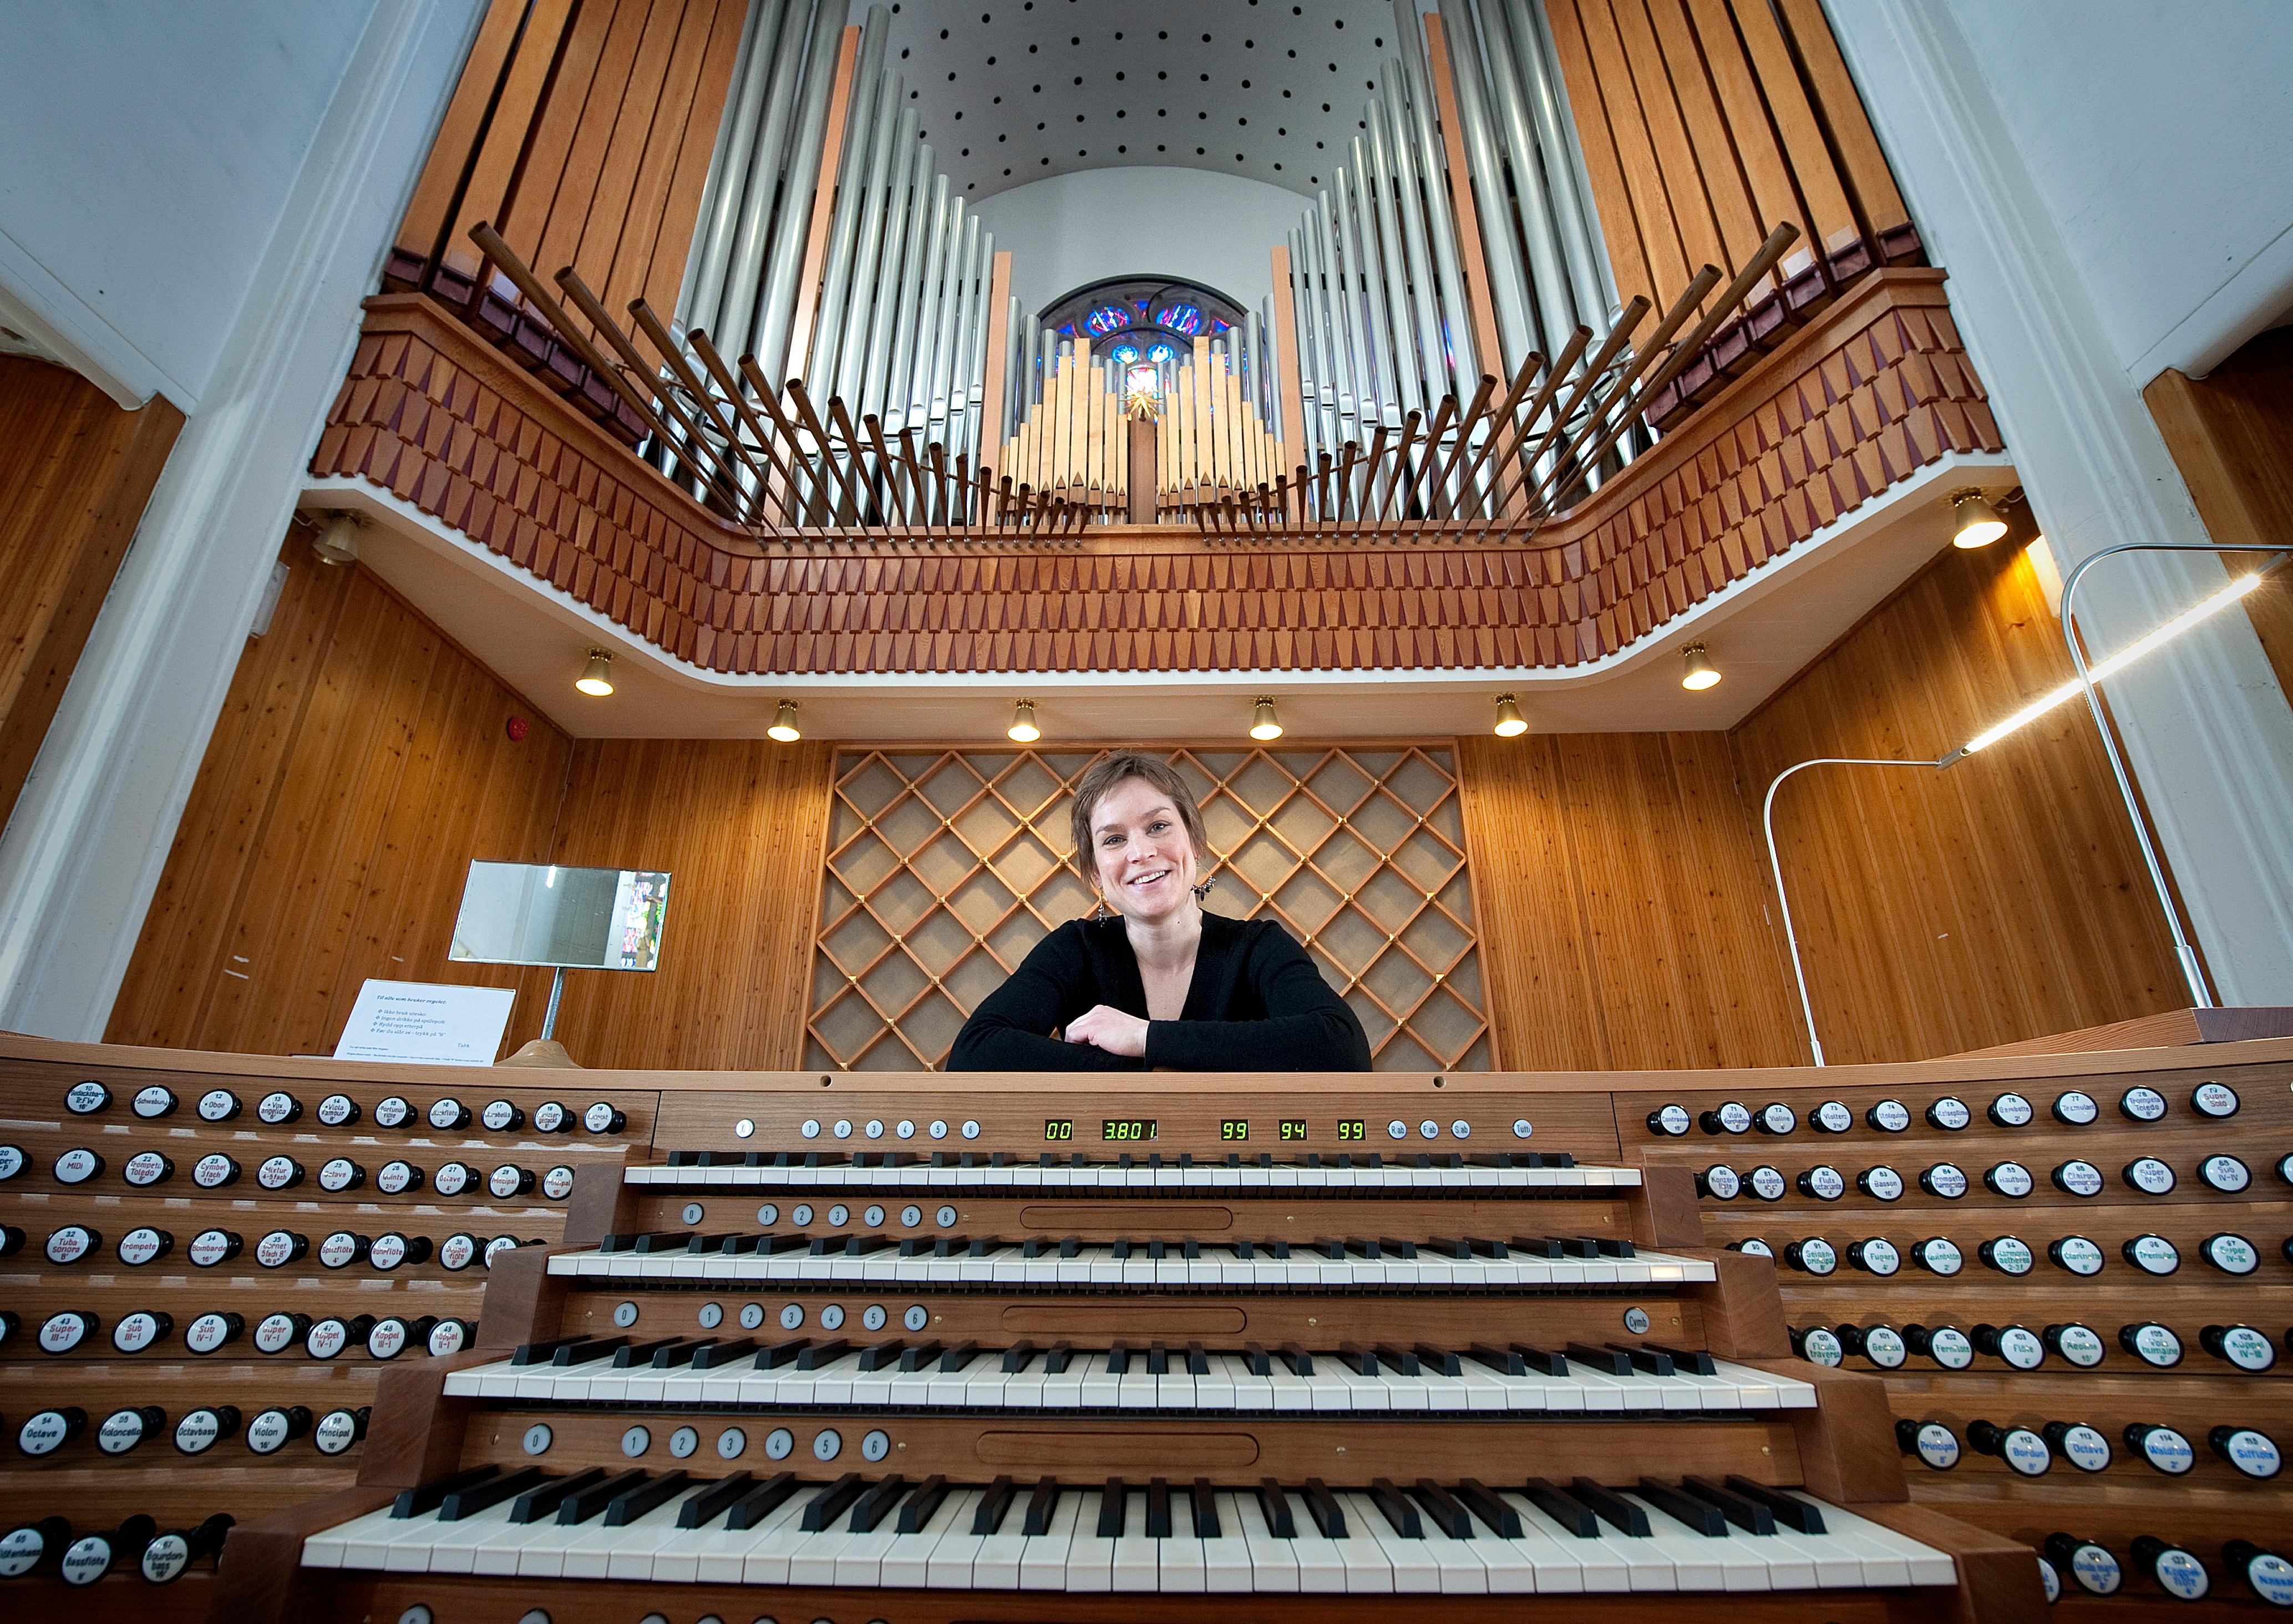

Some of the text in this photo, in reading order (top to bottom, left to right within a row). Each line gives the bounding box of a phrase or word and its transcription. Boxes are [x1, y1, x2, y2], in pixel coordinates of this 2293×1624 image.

[808, 1125, 811, 1133] 1
[841, 1125, 844, 1134] 2
[872, 1125, 876, 1134] 3
[903, 1125, 907, 1134] 4
[936, 1125, 940, 1134] 5
[969, 1125, 972, 1134] 6
[1047, 1123, 1071, 1139] 00
[1222, 1122, 1247, 1139] 99
[1281, 1122, 1305, 1139] 94
[1340, 1122, 1363, 1139] 99
[1516, 1124, 1530, 1134] Tutti
[689, 1210, 693, 1219] 0
[765, 1211, 768, 1220] 1
[800, 1211, 804, 1220] 2
[835, 1212, 839, 1220] 3
[871, 1212, 875, 1221] 4
[908, 1212, 912, 1221] 5
[944, 1212, 947, 1221] 6
[322, 1245, 353, 1253] Spitzflöte
[622, 1310, 626, 1319] 0
[708, 1312, 711, 1321] 1
[748, 1312, 753, 1322] 2
[789, 1312, 793, 1322] 3
[829, 1312, 833, 1322] 4
[871, 1313, 875, 1323] 5
[913, 1313, 917, 1323] 6
[1629, 1316, 1647, 1329] Cymb
[27, 1429, 58, 1438] Octave
[533, 1435, 537, 1447] 0
[632, 1438, 636, 1448] 1
[679, 1438, 684, 1449] 2
[727, 1438, 732, 1449] 3
[775, 1438, 780, 1451] 4
[823, 1439, 828, 1452] 5
[871, 1440, 877, 1453] 6
[1921, 1441, 1956, 1452] Principal
